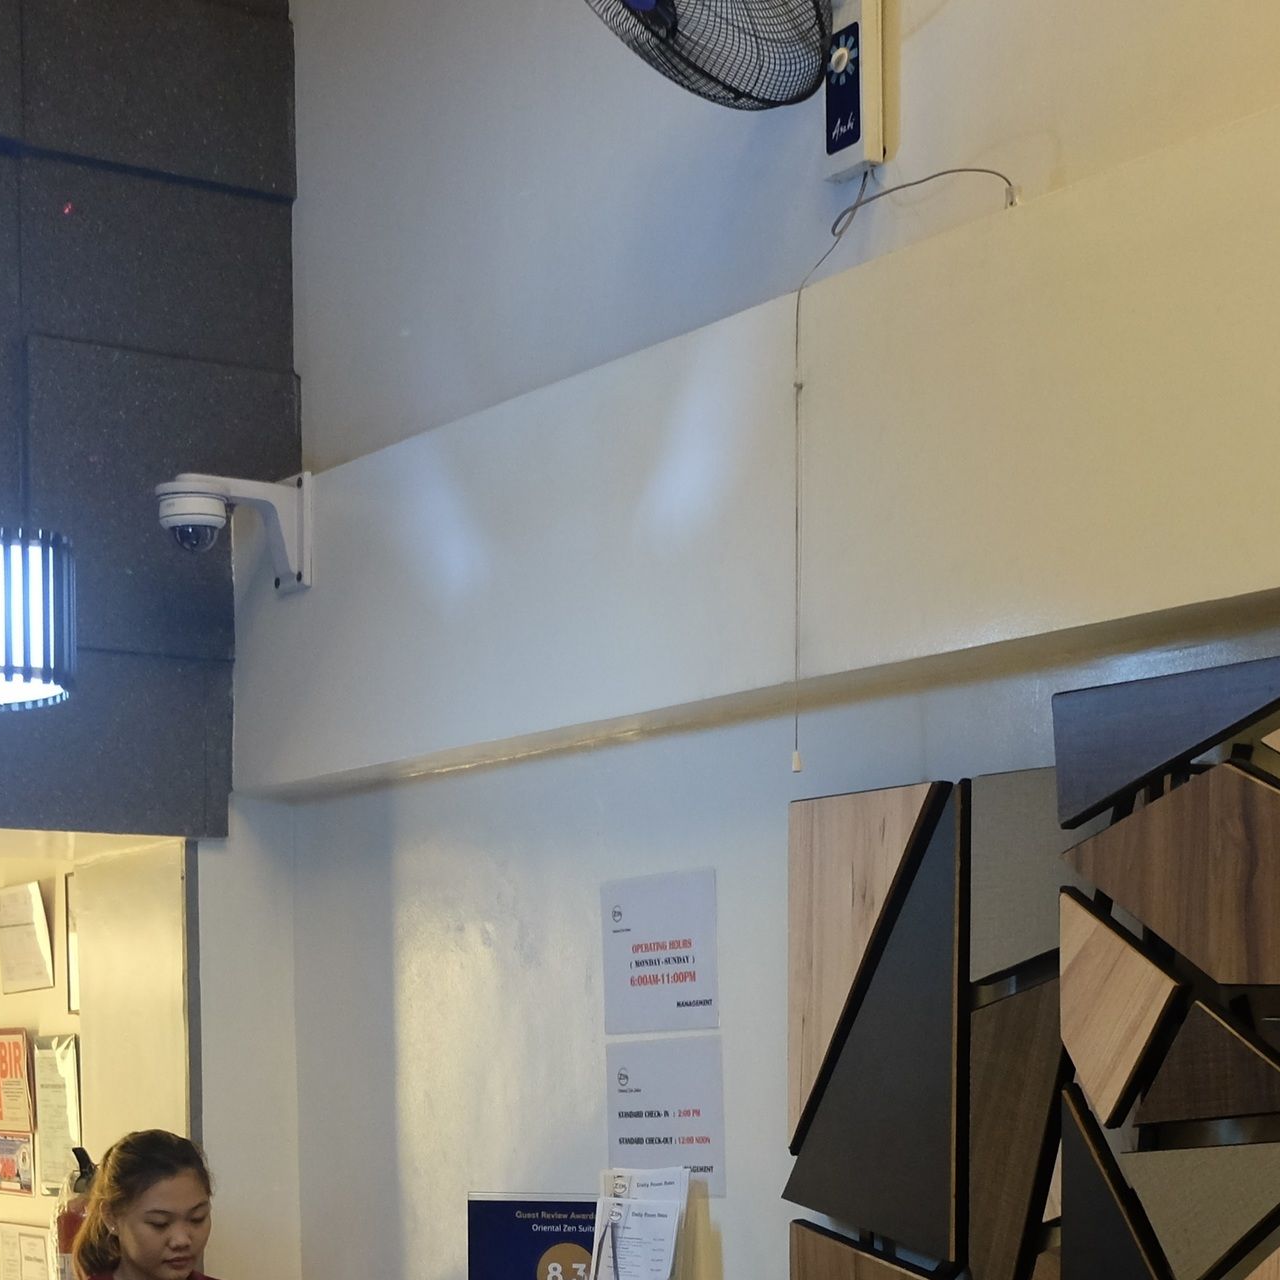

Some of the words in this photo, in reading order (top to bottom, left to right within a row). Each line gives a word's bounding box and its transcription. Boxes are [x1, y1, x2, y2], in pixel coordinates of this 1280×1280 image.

[631, 941, 668, 954] OPERATING
[668, 938, 693, 951] HOURS
[630, 970, 697, 987] 6:00AM-11:00PM
[676, 999, 713, 1008] MANAGEMENT
[0, 1040, 24, 1079] BIR
[515, 1210, 539, 1219] Guest
[541, 1211, 568, 1219] Review
[531, 1223, 562, 1232] Oriental
[562, 1224, 577, 1232] Zen
[578, 1224, 595, 1233] Suite
